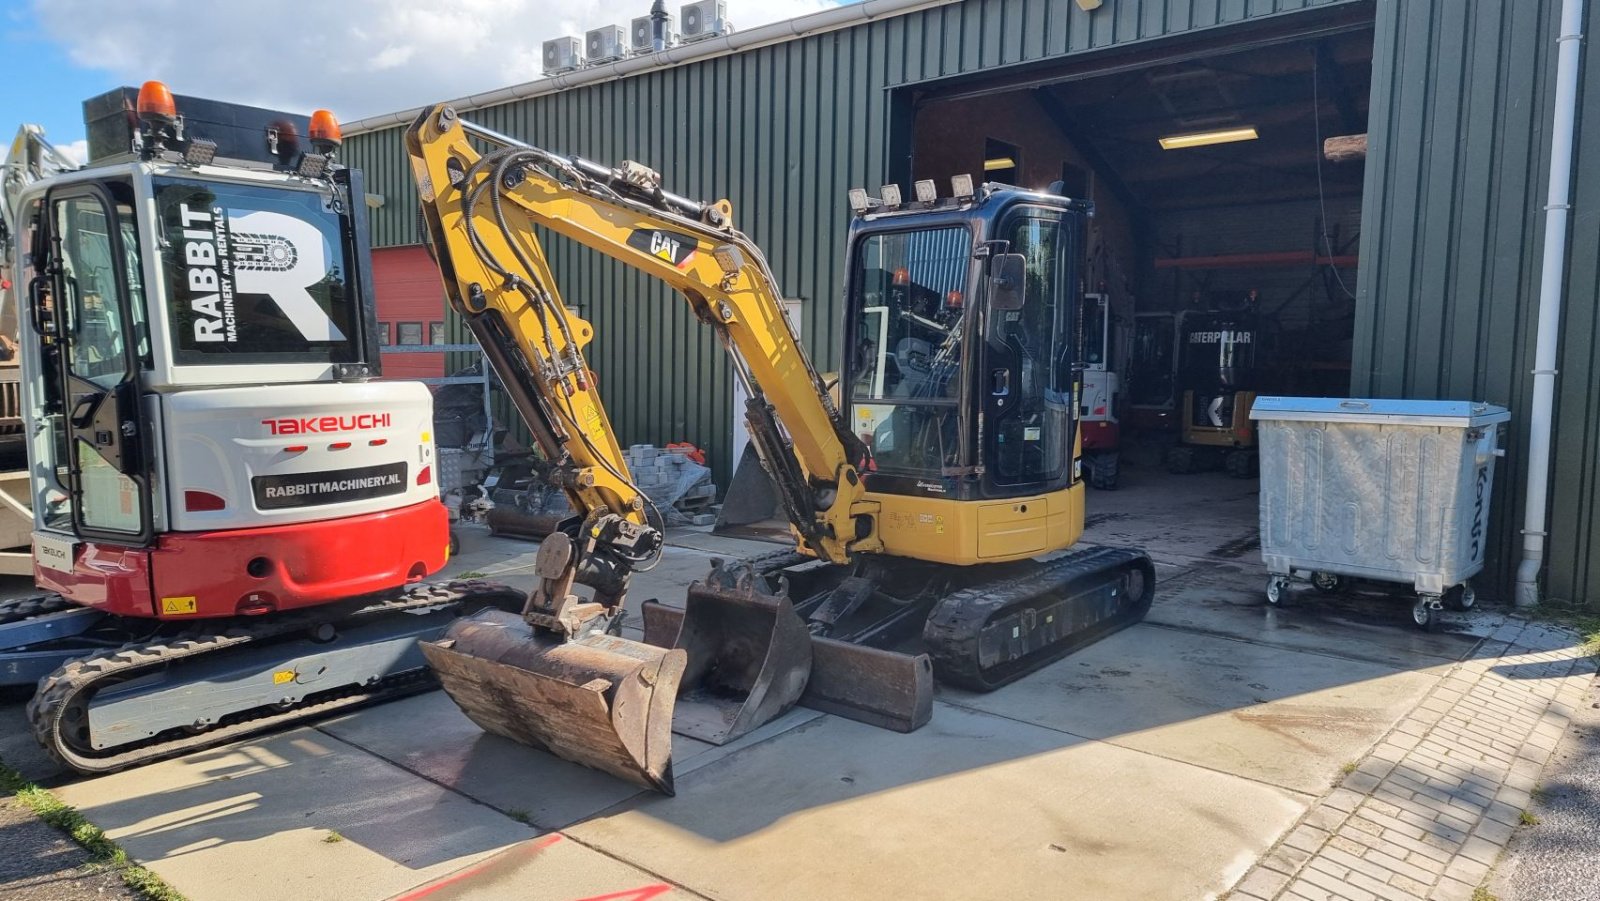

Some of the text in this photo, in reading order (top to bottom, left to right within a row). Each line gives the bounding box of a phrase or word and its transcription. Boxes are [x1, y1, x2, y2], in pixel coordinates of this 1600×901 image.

[651, 231, 681, 263] CAT
[180, 203, 225, 342] RABBIT
[213, 206, 238, 342] MACHINERY AND RENTALS
[261, 413, 391, 435] TAKEUCHI
[265, 474, 401, 498] RABBITMACHINERY.NL
